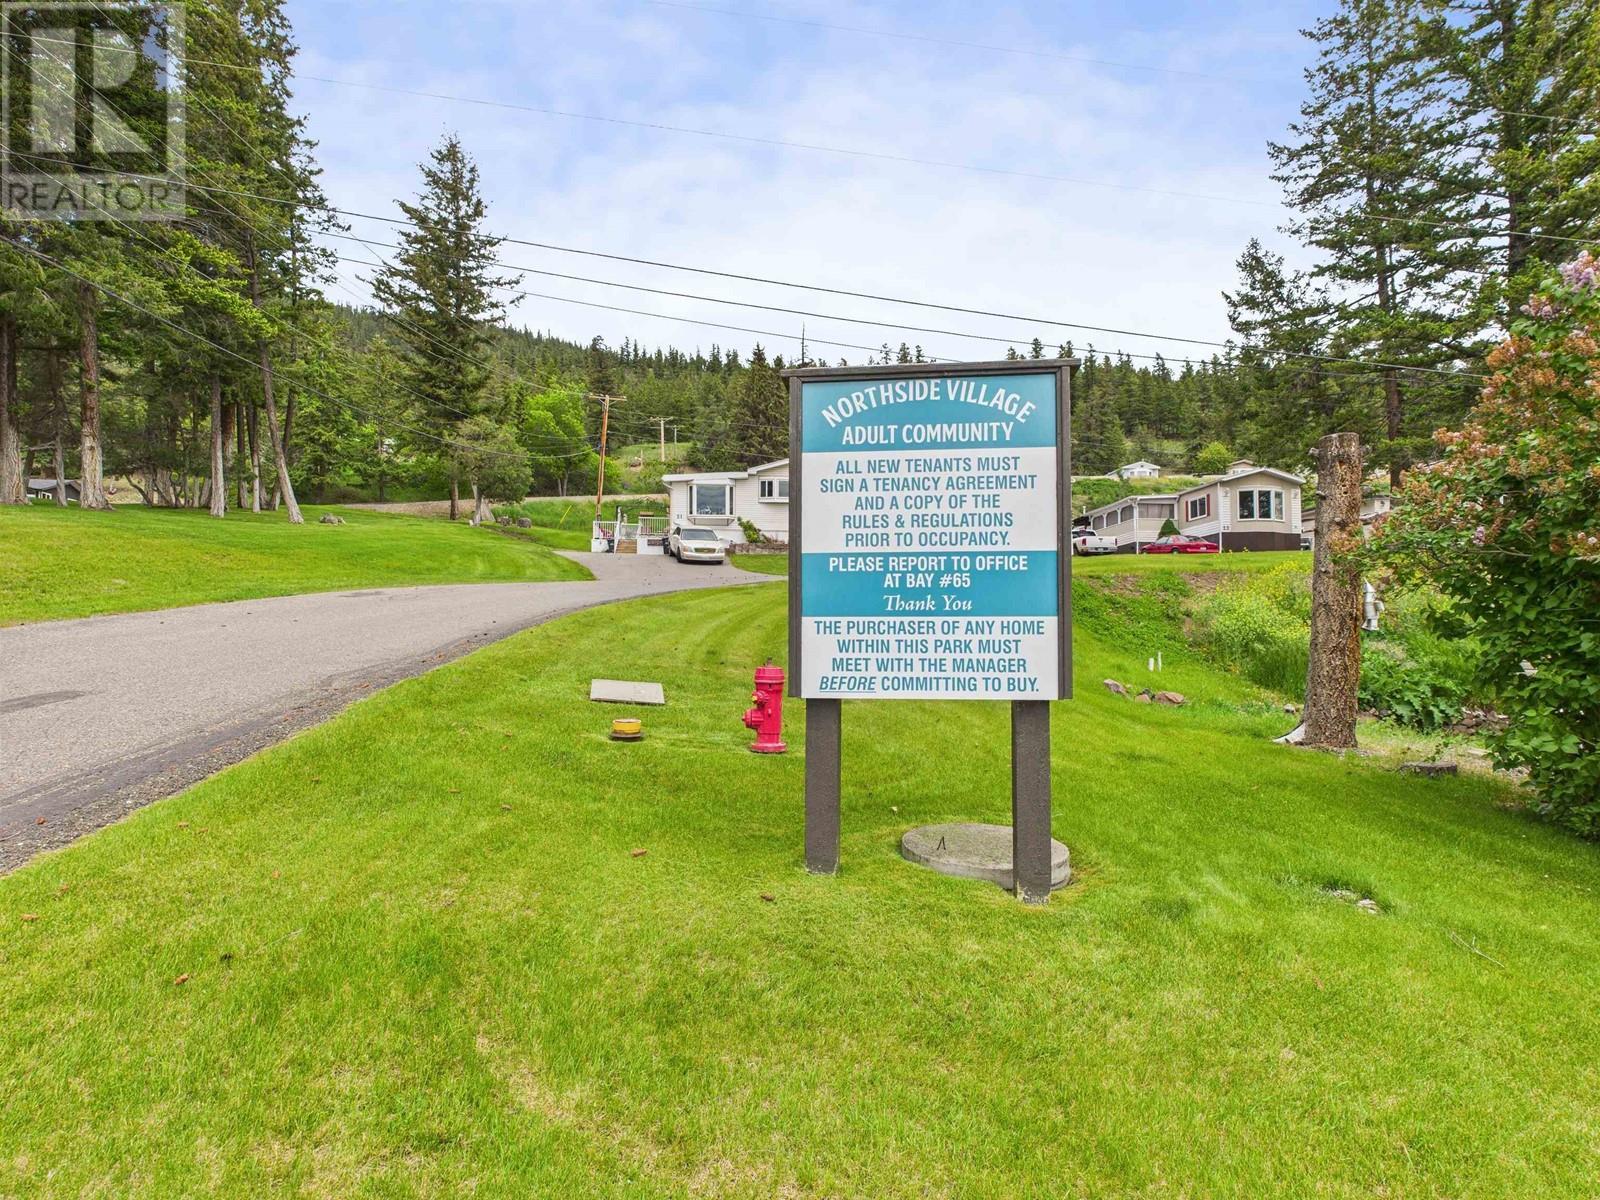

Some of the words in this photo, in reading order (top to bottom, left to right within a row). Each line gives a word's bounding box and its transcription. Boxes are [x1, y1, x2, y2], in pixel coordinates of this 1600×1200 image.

[821, 379, 941, 427] NORTHSIDE
[947, 379, 1036, 423] VILLAGE
[842, 425, 898, 445] ADULT
[902, 422, 1014, 443] COMMUNITY
[836, 460, 862, 474] ALL
[867, 459, 900, 473] NEW
[905, 458, 971, 473] TENANTS
[977, 457, 1020, 471] MUST
[820, 479, 854, 493] SIGN
[859, 478, 868, 492] A
[873, 477, 941, 491] TENANCY
[946, 475, 1037, 490] AGREEMENT
[855, 496, 884, 510] AND
[890, 496, 899, 509] A
[904, 495, 943, 509] COPY
[948, 495, 967, 509] OF
[972, 494, 1000, 508] THE
[842, 514, 889, 528] RULES
[895, 514, 905, 528] &
[911, 512, 1013, 528] REGULATIONS
[845, 533, 890, 547] PRIOR
[895, 532, 913, 547] TO
[918, 531, 1010, 546] OCCUPANCY.
[829, 557, 883, 571] PLEASE
[889, 556, 946, 571] REPORT
[952, 556, 970, 570] TO
[976, 555, 1028, 570] OFFICE
[884, 573, 902, 587] AT
[907, 573, 934, 587] BAY
[939, 573, 971, 587] #65
[883, 595, 936, 610] Thank
[942, 595, 972, 610] You
[814, 621, 841, 634] THE
[847, 620, 935, 635] PURCHASER
[941, 621, 959, 635] OF
[965, 621, 995, 635] ANY
[1000, 621, 1044, 635] HOME
[837, 639, 890, 653] WITHIN
[895, 639, 928, 653] THIS
[934, 639, 972, 653] PARK
[978, 639, 1021, 654] MUST
[832, 658, 871, 672] MEET
[876, 658, 913, 672] WITH
[919, 658, 946, 672] THE
[952, 658, 1026, 673] MANAGER
[819, 676, 876, 693] BEFORE
[881, 676, 977, 691] COMMITTING
[982, 676, 1001, 691] TO
[1007, 676, 1039, 692] BUY.
